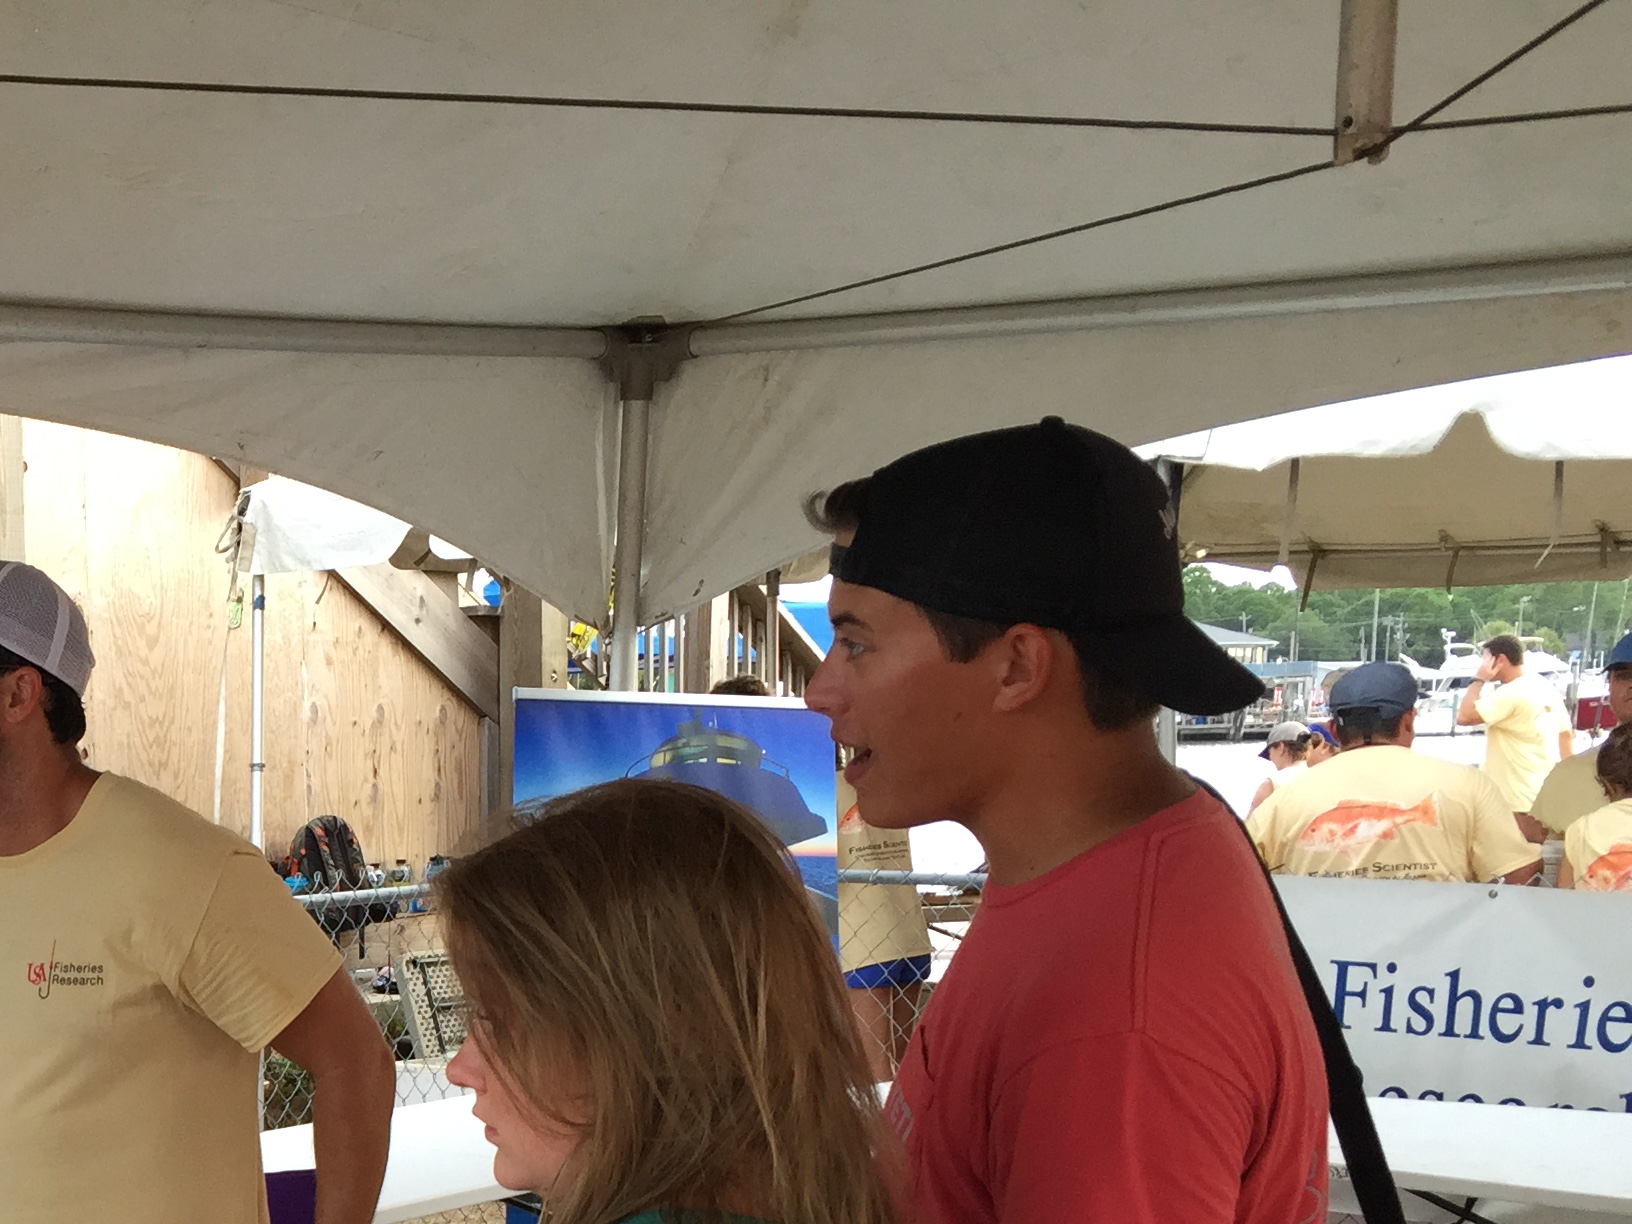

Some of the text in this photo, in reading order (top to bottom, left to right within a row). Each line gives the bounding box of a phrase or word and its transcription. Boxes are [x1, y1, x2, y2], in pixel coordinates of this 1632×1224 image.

[1372, 861, 1438, 873] SCIENTIST
[53, 961, 104, 974] Fisheries
[52, 974, 104, 986] Research
[1329, 958, 1632, 1054] Fisherie
